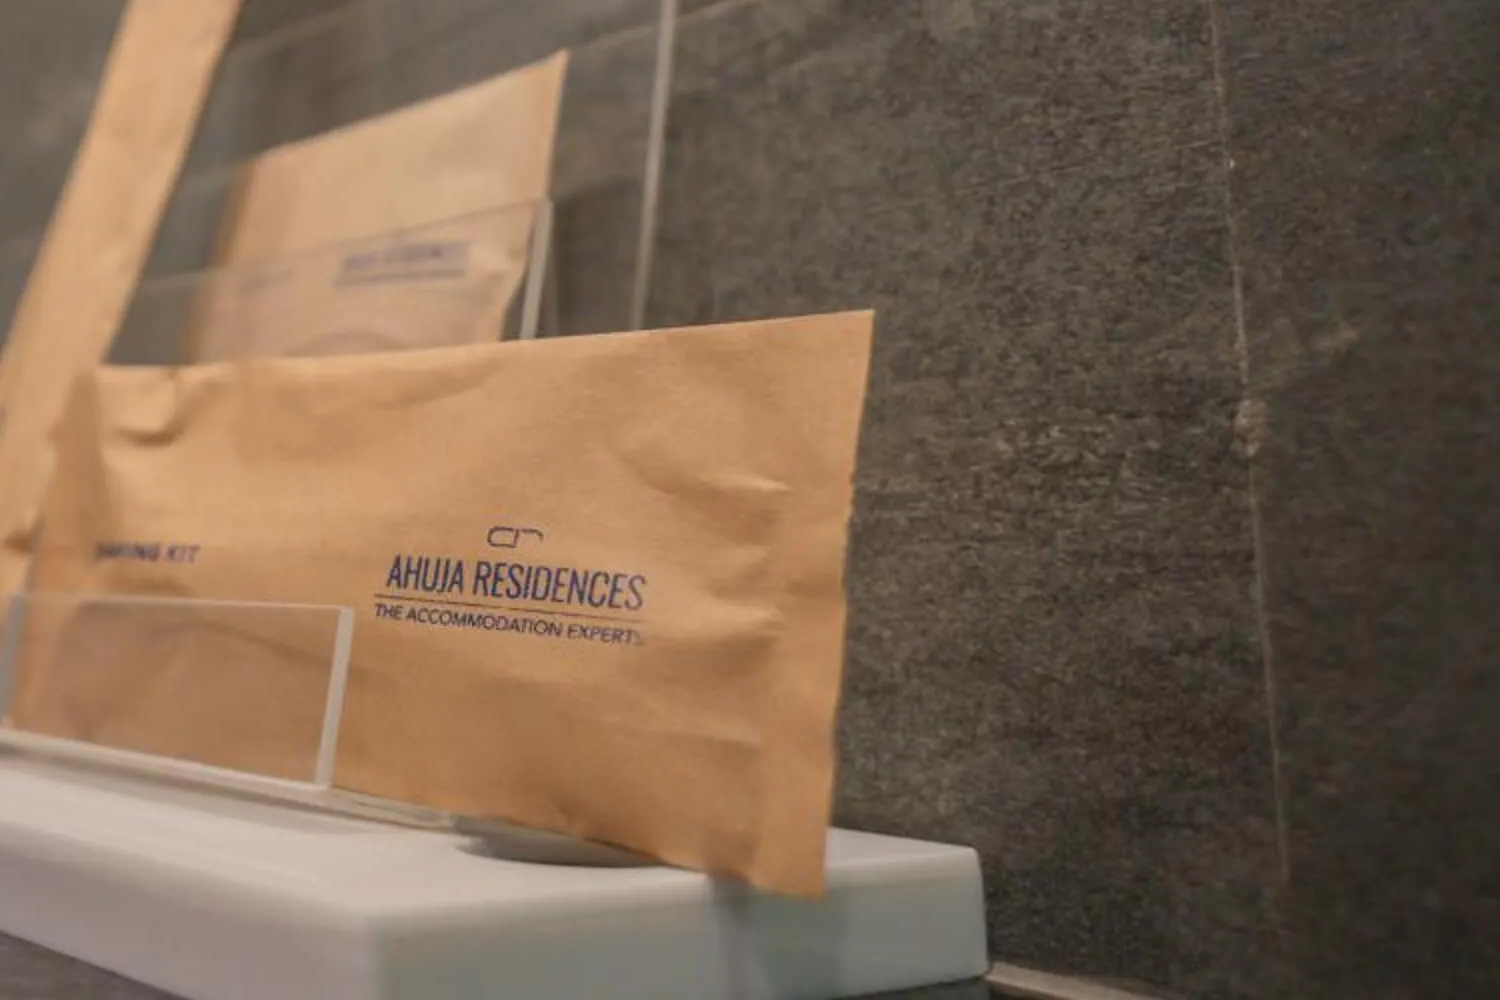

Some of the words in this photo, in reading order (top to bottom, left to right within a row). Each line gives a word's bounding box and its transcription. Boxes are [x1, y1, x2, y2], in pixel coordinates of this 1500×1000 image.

[386, 554, 464, 594] AHUJA
[473, 560, 646, 610] RESIDENCES
[375, 602, 404, 620] THE
[406, 607, 563, 637] ACCOMMODATION
